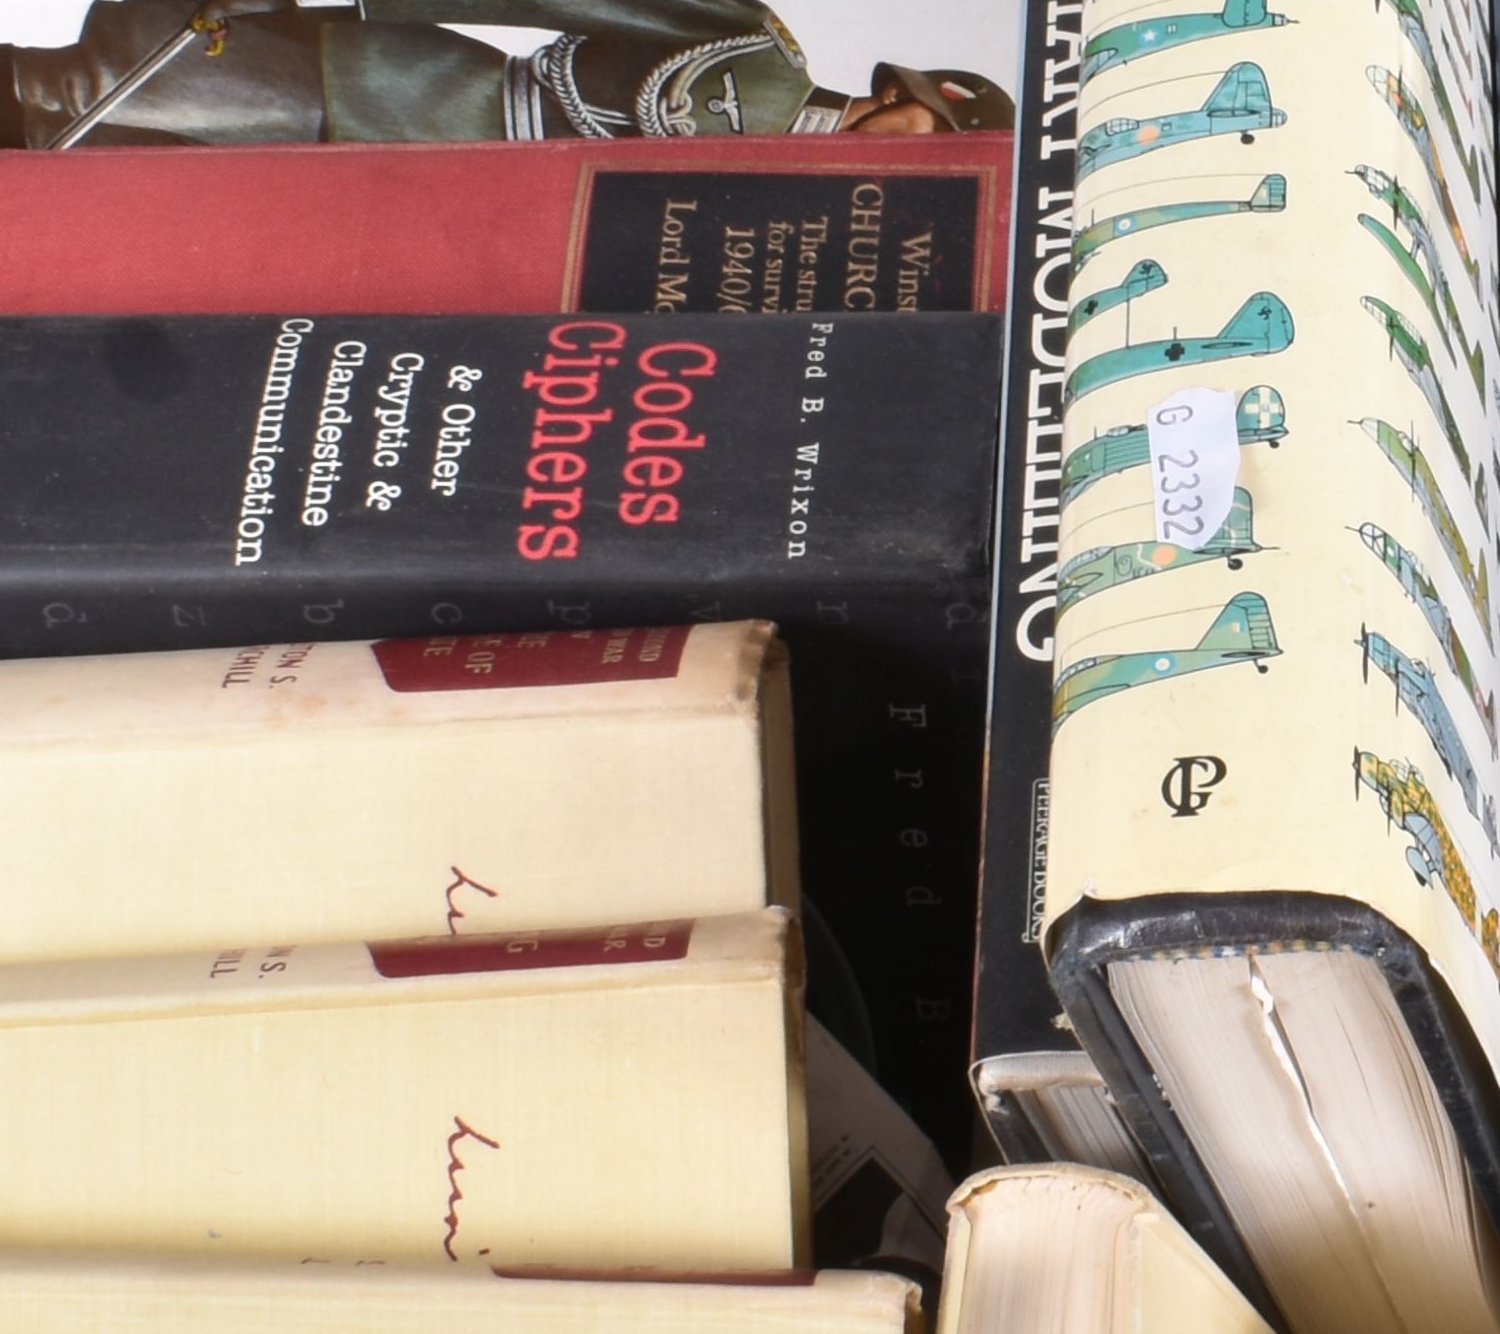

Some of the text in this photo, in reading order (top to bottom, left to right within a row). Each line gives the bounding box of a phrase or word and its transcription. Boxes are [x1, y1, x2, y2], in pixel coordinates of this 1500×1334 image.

[658, 197, 699, 266] Lord
[760, 220, 795, 314] for survi
[796, 216, 829, 314] The stru
[842, 182, 886, 313] CHURC
[895, 231, 934, 314] Winst
[234, 317, 315, 567] Communication
[300, 339, 368, 530] Clandestine
[364, 351, 426, 514] Cryptic &
[430, 363, 483, 498] & Other
[515, 319, 628, 563] Ciphers
[618, 339, 718, 528] Codes
[787, 320, 835, 560] Fred B. Wrixon
[1155, 403, 1205, 541] G 2332
[464, 651, 495, 675] OF
